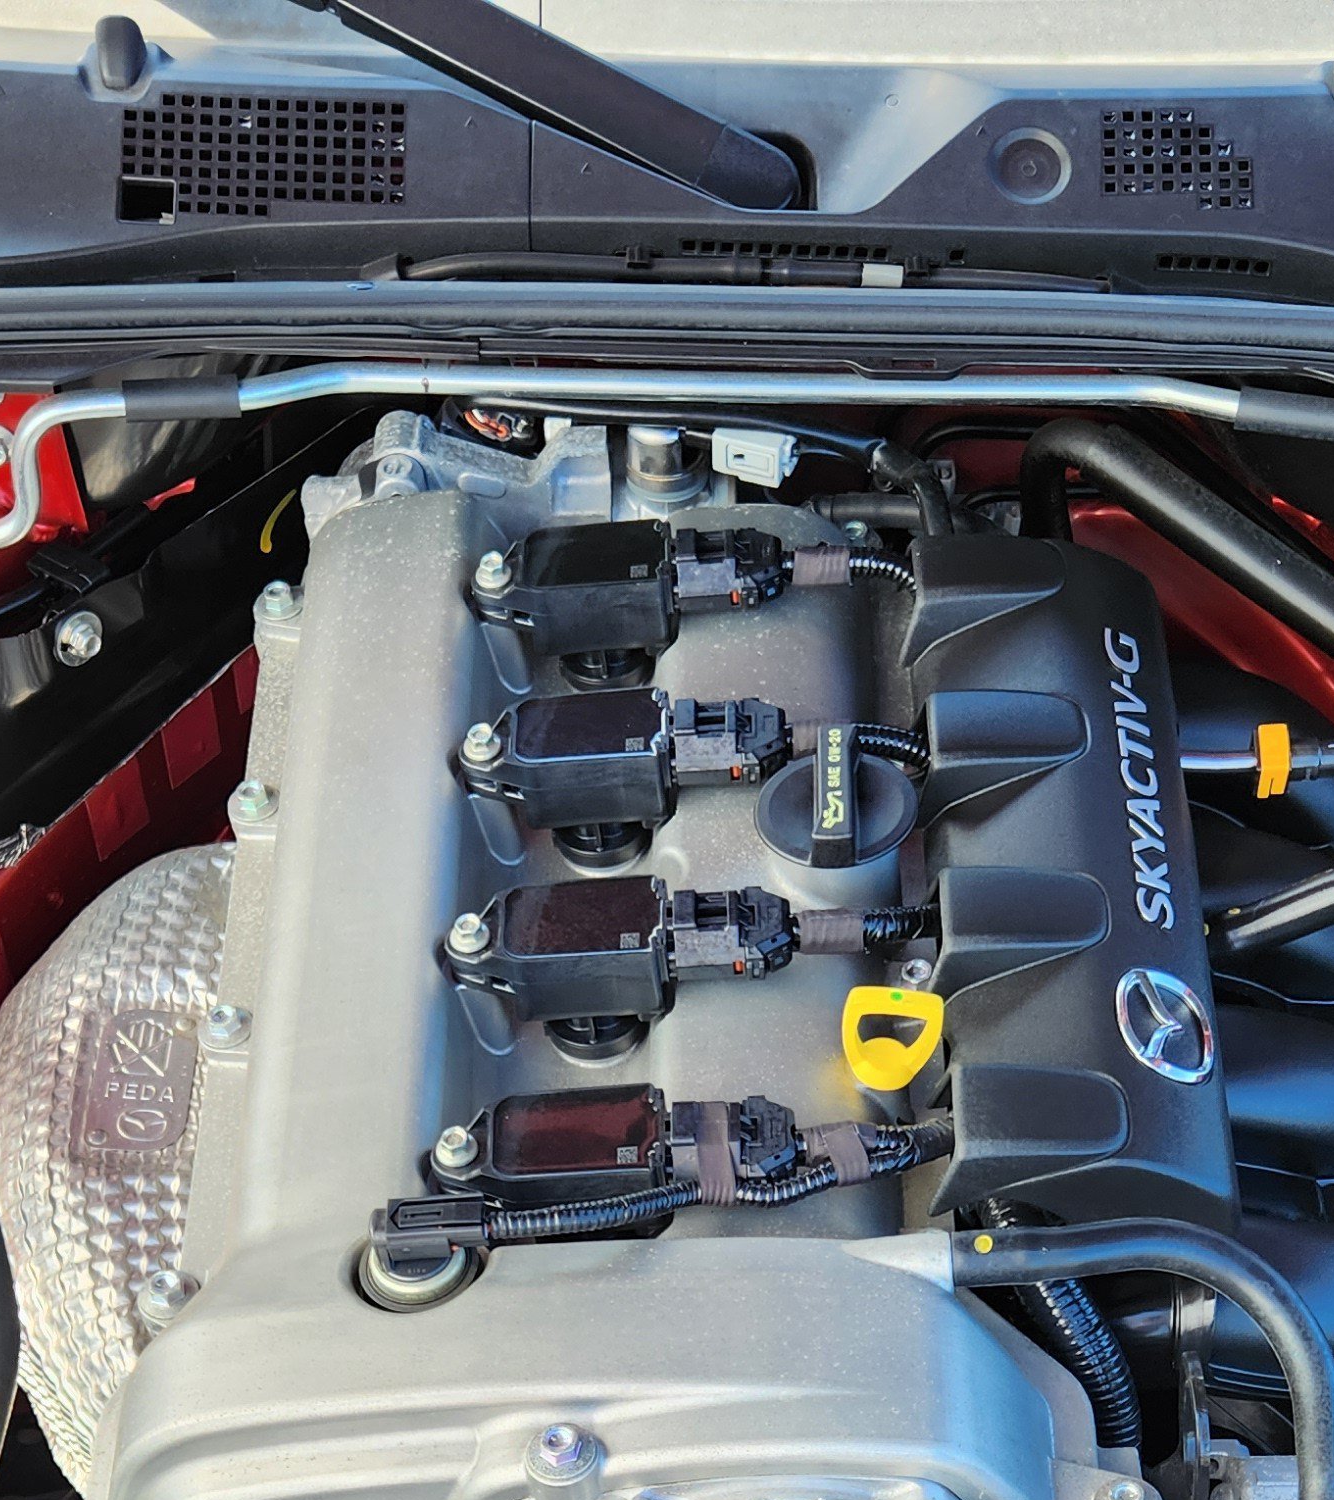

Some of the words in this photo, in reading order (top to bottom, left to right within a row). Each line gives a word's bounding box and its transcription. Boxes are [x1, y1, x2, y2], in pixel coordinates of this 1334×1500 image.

[827, 766, 841, 786] SAE
[1104, 628, 1174, 931] SKYACTIV-G
[105, 1080, 174, 1103] PEDA
